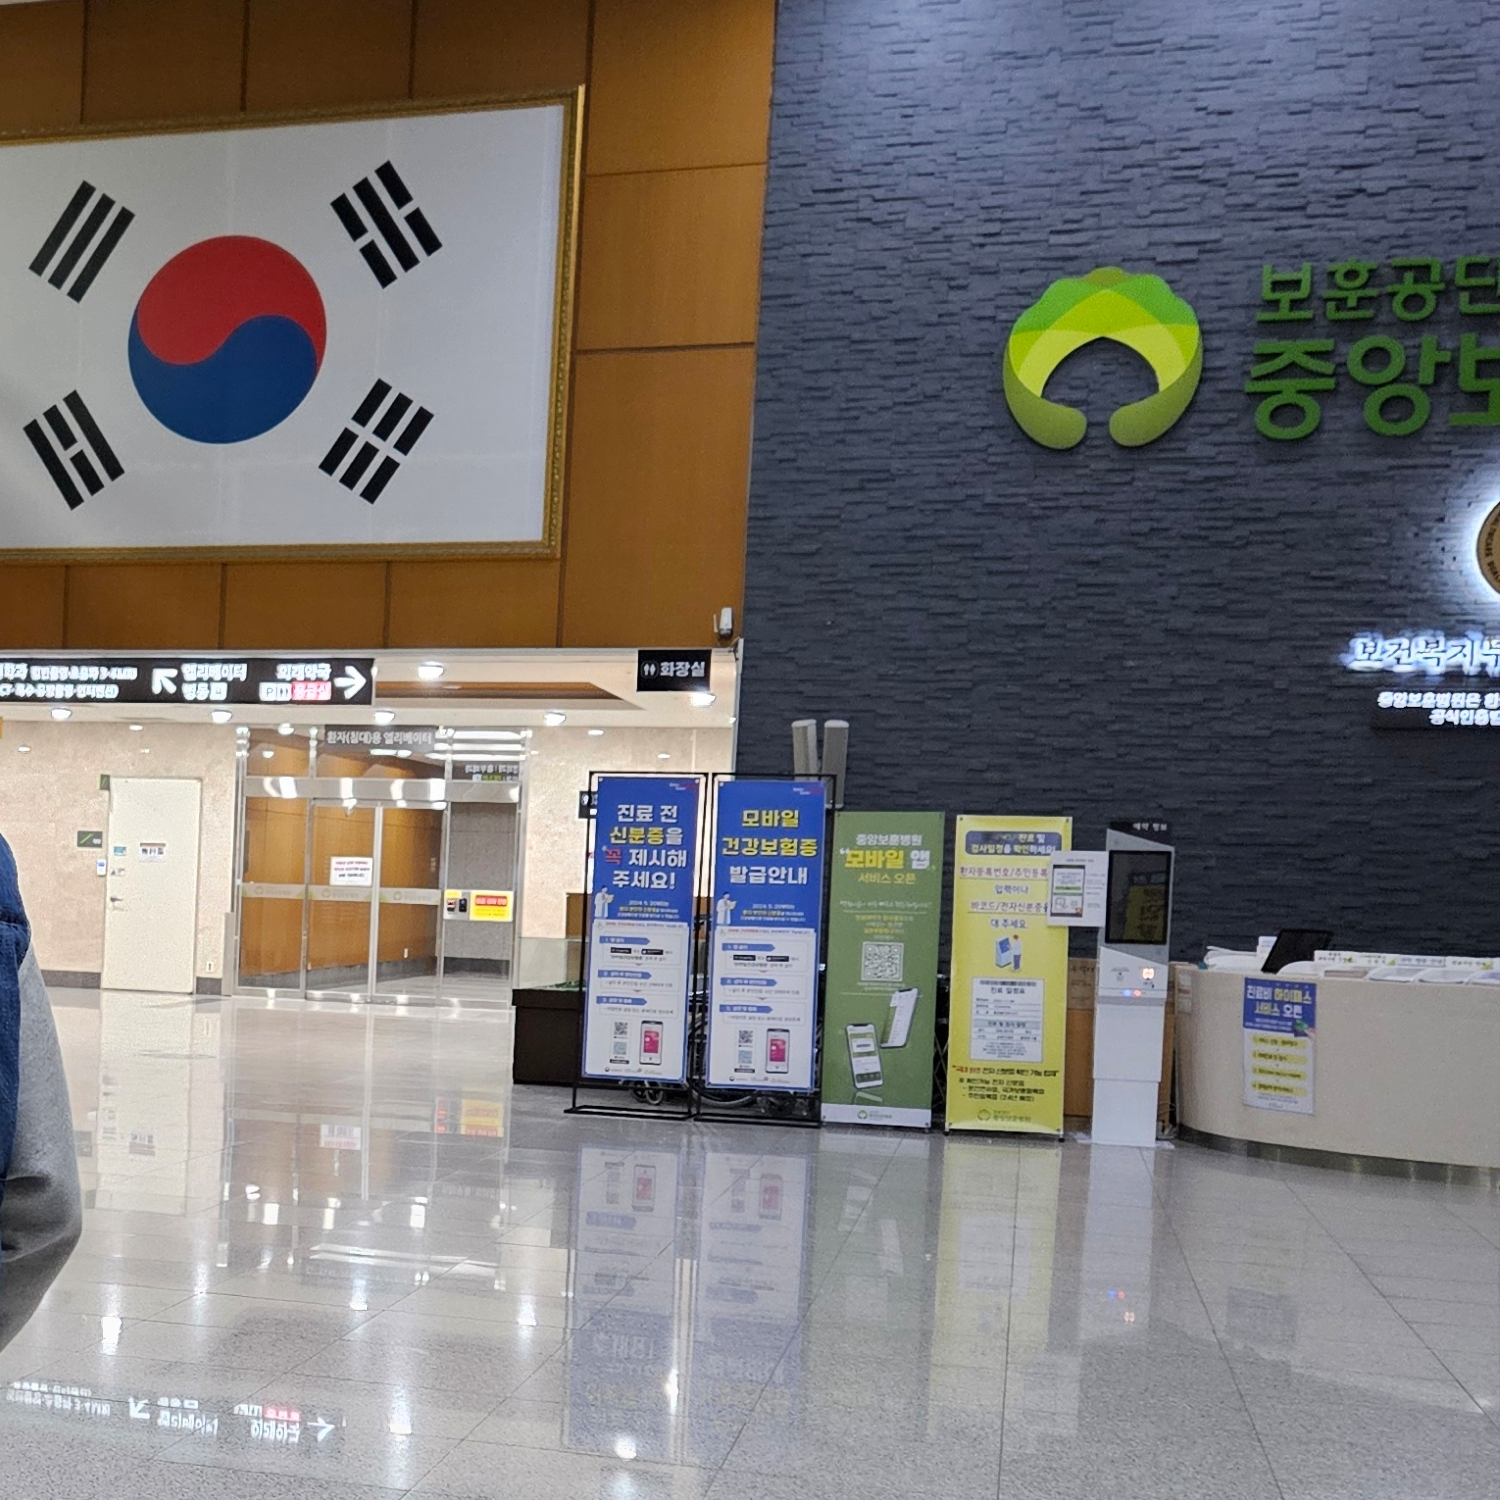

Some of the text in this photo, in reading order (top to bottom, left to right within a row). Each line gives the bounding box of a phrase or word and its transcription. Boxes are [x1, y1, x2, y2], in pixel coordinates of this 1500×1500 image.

[180, 662, 248, 682] 엘리베이터
[276, 662, 332, 681] 외래약국
[660, 661, 706, 678] 화장실
[326, 730, 432, 745] 환자(침대)용 엘리베이터
[617, 804, 678, 823] 진료 전
[741, 809, 799, 828] 모바일
[609, 826, 683, 845] 신분증을
[721, 838, 818, 857] 건강보험증
[604, 847, 687, 868] 꼭 제시해
[611, 870, 676, 889] 주세요!
[729, 865, 808, 885] 발급안내
[858, 872, 917, 885] 서비스 오픈
[994, 884, 1029, 895] 입력이나
[1274, 987, 1312, 1004] 하이패스
[1254, 1001, 1303, 1019] 서비스 오픈
